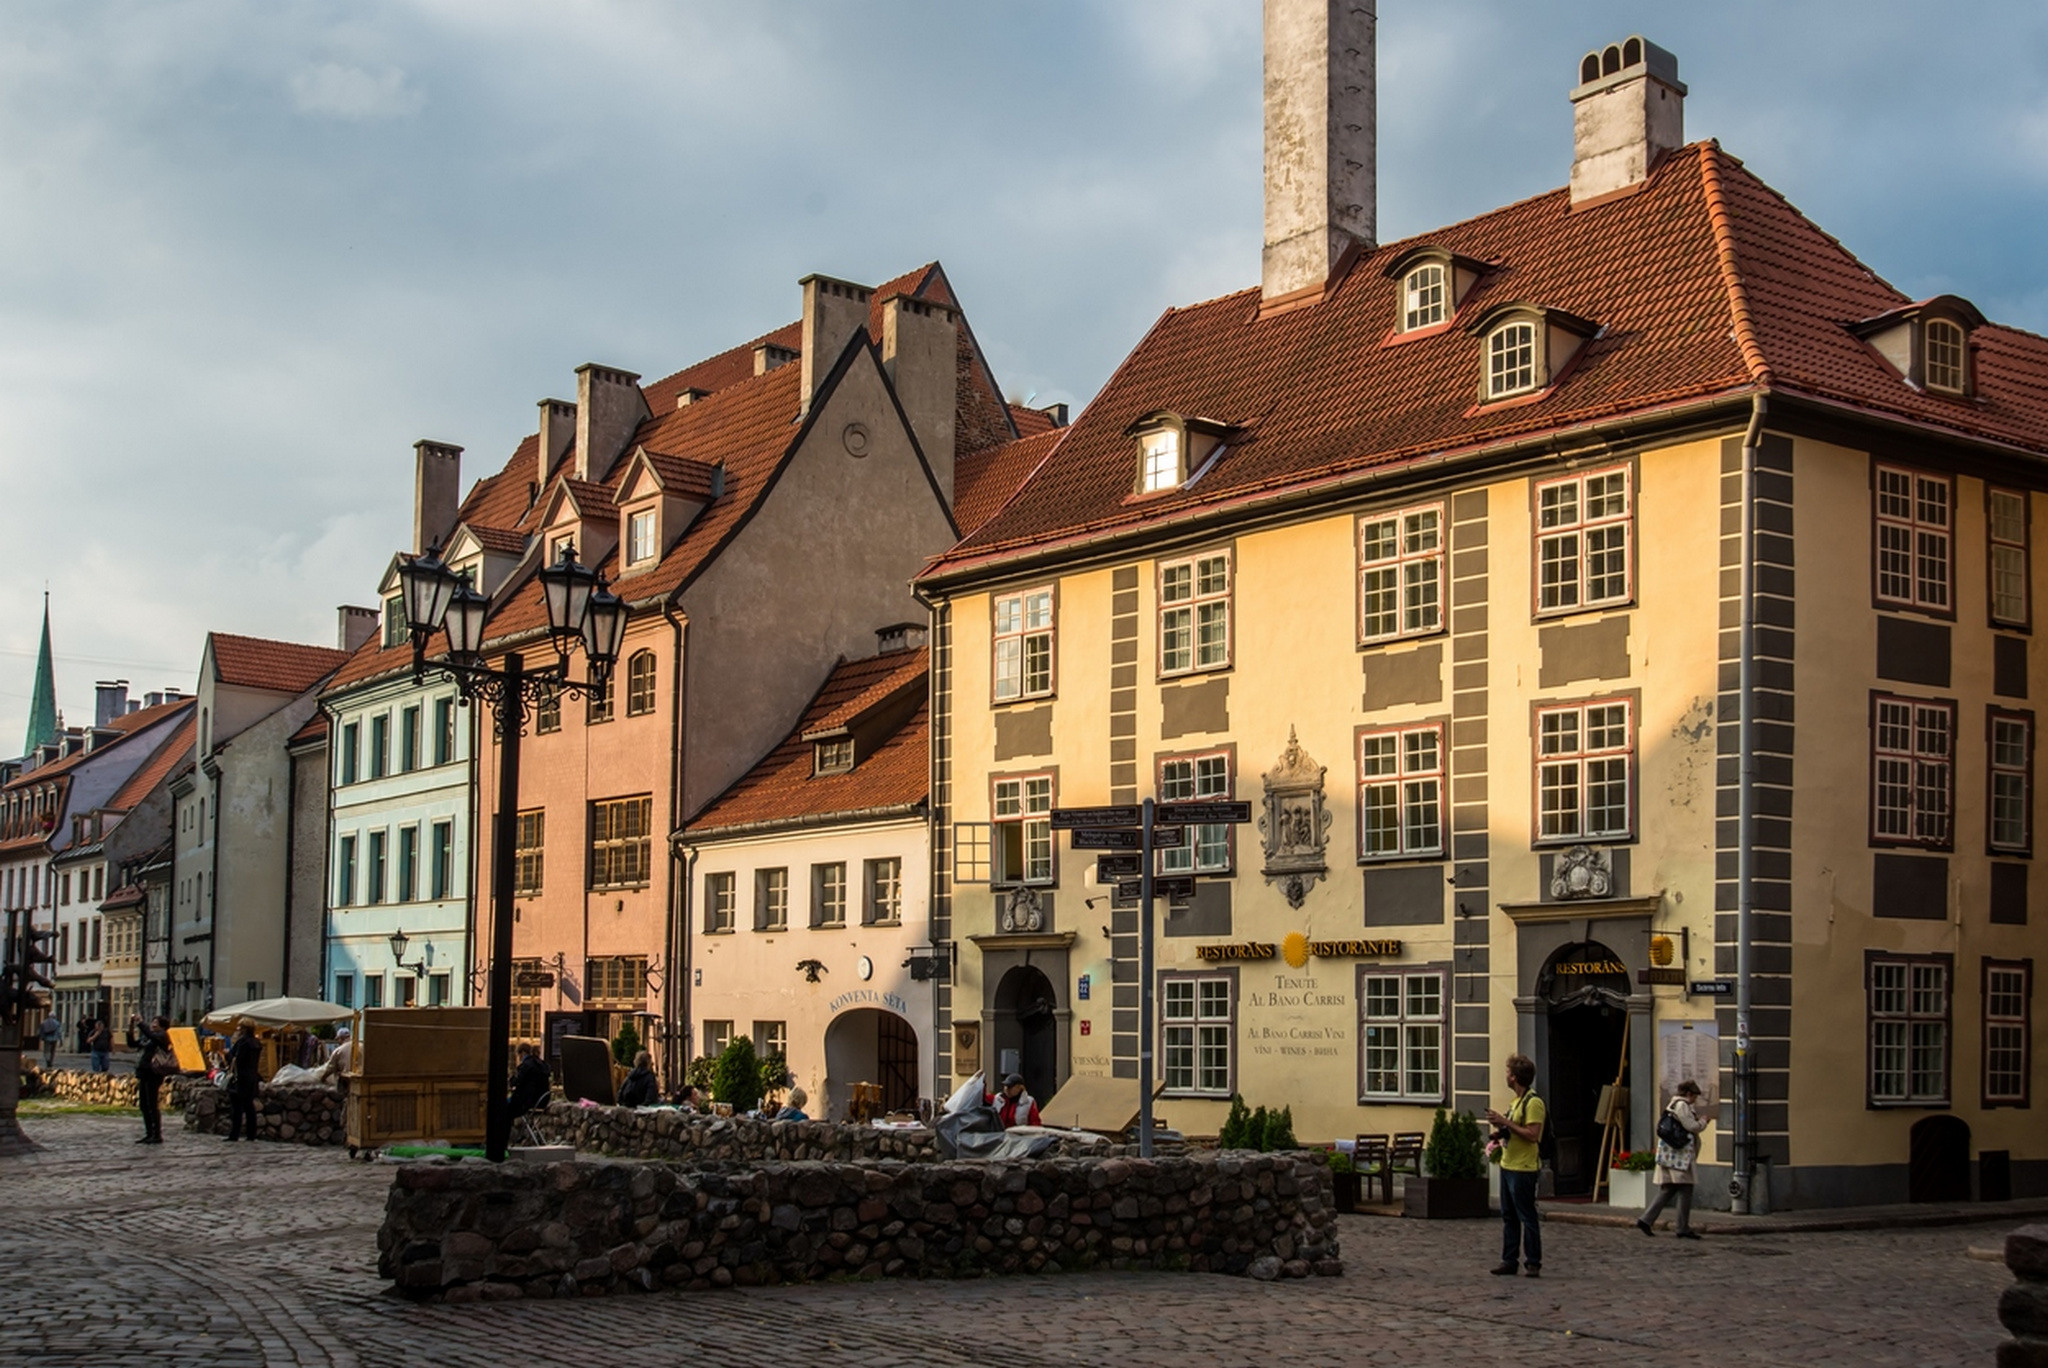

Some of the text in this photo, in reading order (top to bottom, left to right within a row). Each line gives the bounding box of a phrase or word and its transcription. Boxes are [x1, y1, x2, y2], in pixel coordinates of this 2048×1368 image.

[1196, 940, 1401, 960] RESTORĀNS RISTORANTE
[1556, 960, 1626, 974] RESTORĀNS
[829, 989, 880, 1013] KONVENTA
[1268, 992, 1300, 1006] BANO
